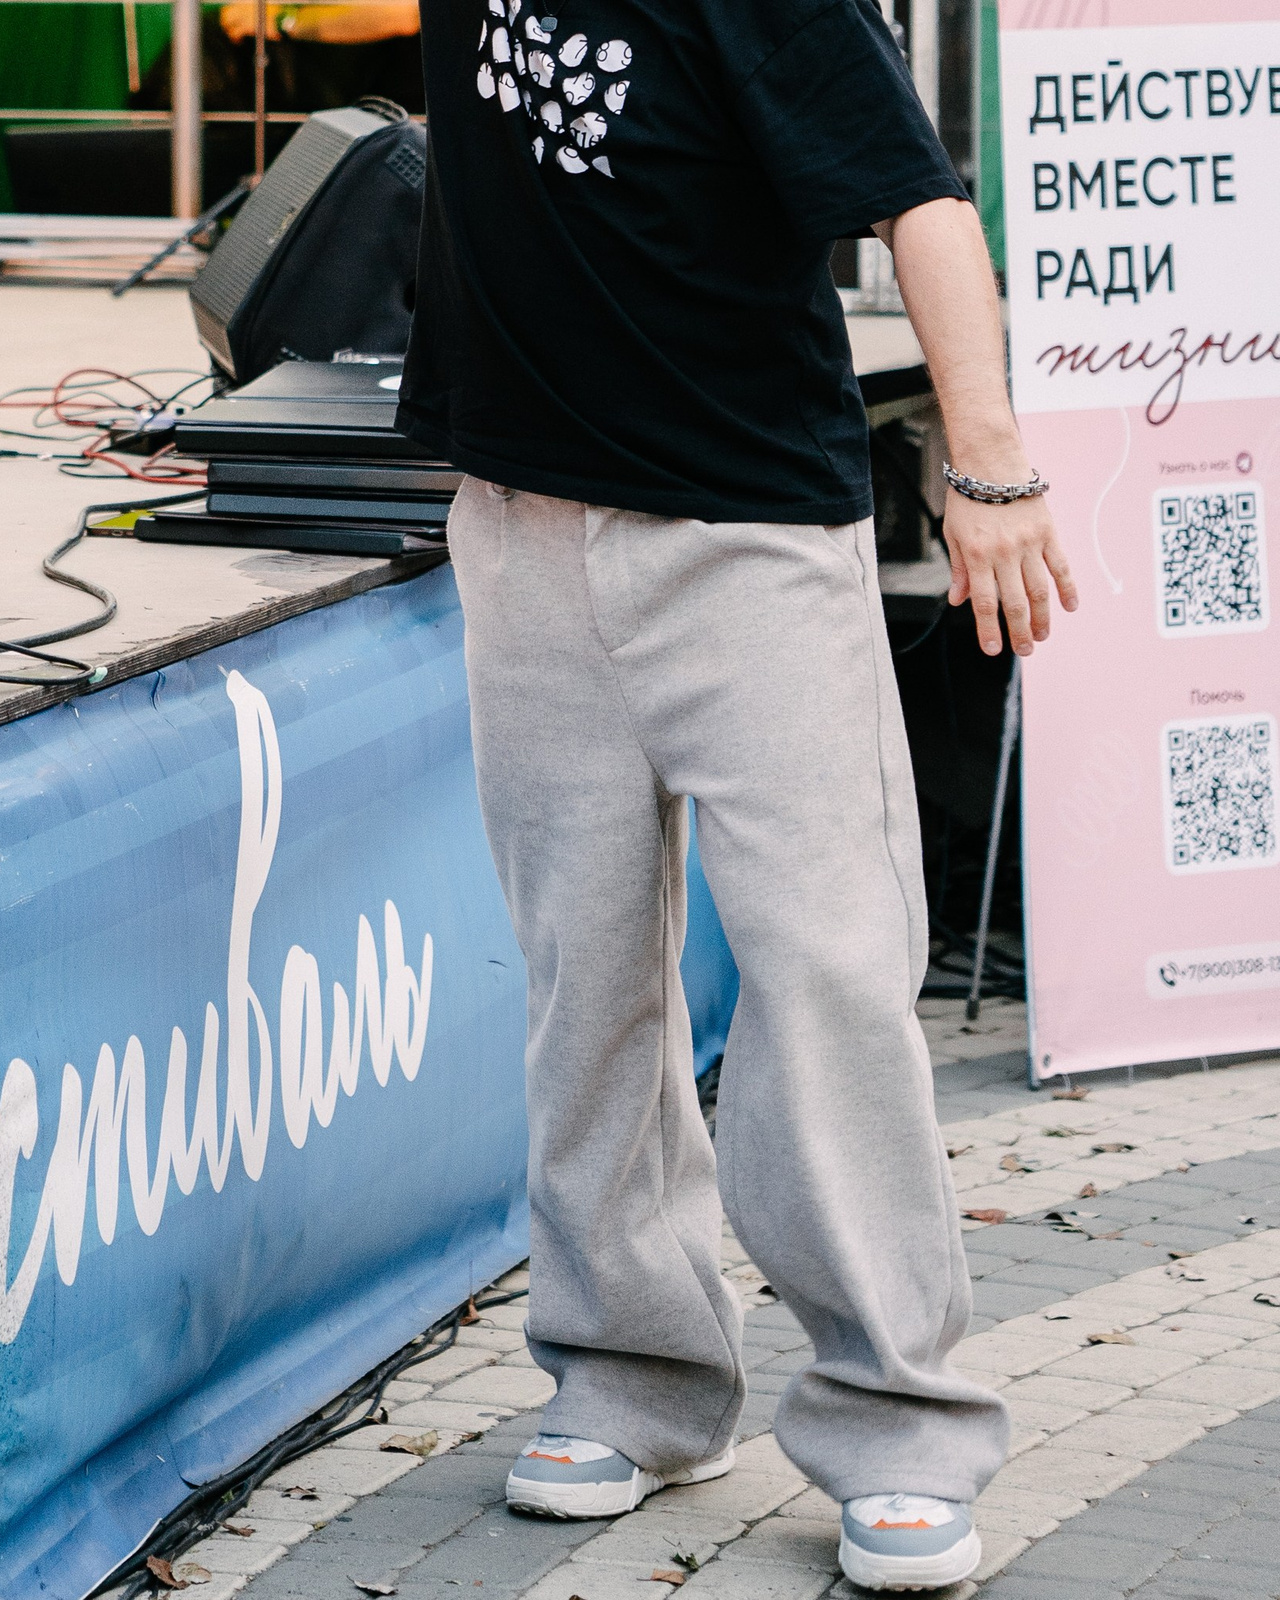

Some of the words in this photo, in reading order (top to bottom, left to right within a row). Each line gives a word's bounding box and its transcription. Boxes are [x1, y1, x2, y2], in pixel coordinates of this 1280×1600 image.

[1033, 153, 1237, 213] ВМЕСТЕ
[1036, 243, 1175, 306] РАДИ
[1036, 327, 1280, 426] жизни
[1191, 688, 1246, 705] Помочь
